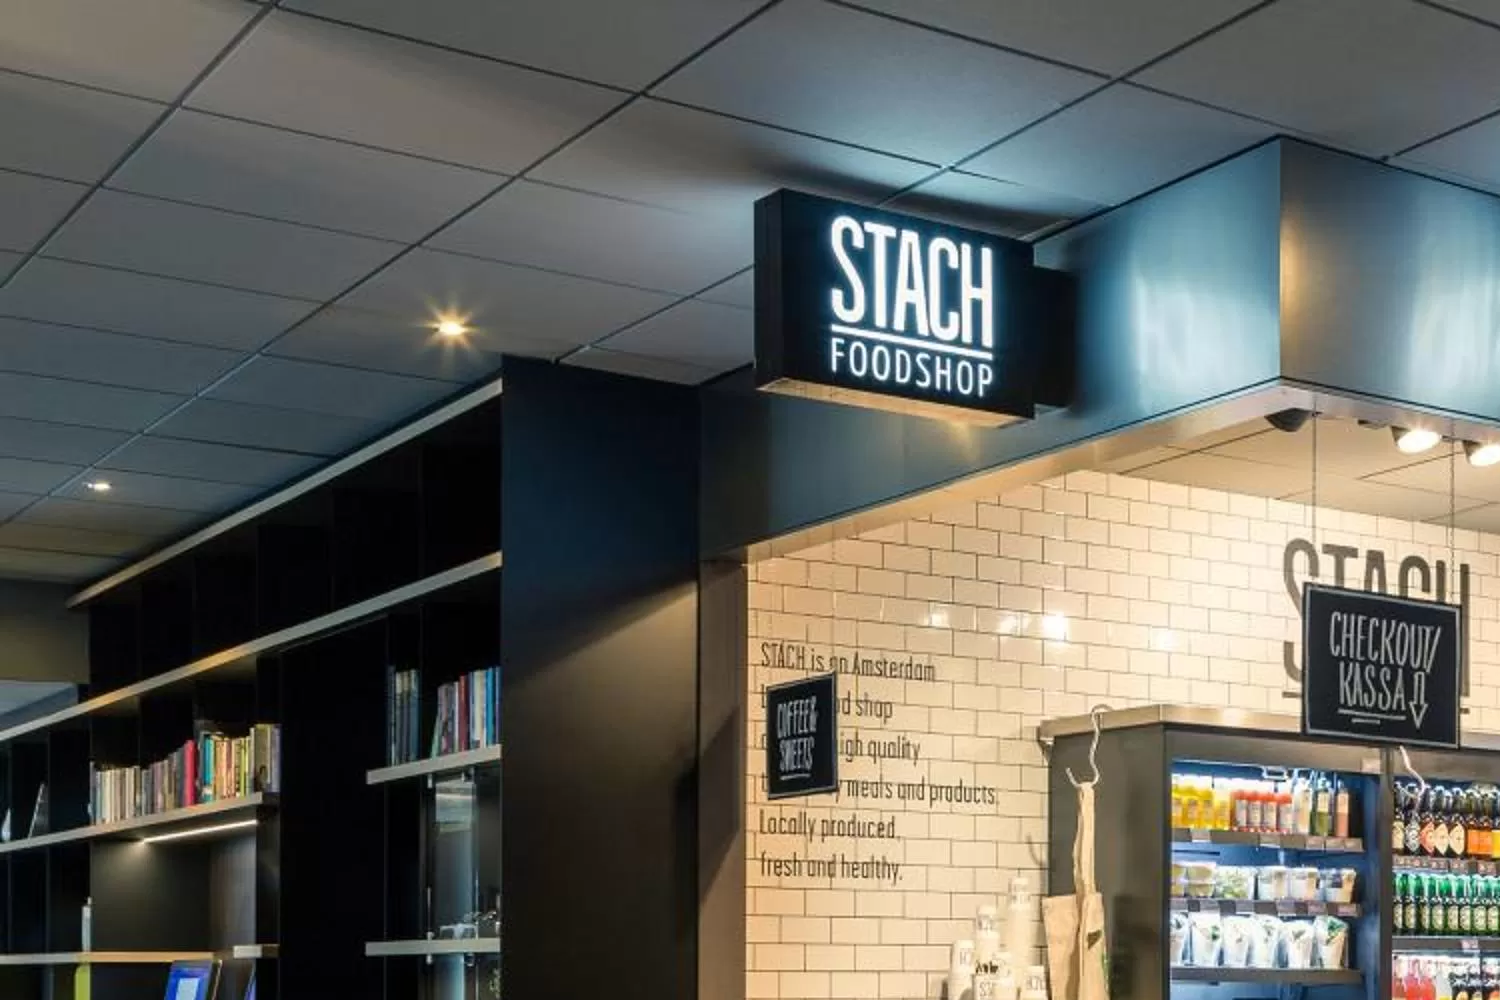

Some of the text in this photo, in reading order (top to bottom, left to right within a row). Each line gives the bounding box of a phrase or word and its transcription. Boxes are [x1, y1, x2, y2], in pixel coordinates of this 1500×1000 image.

[830, 215, 993, 347] STACH
[830, 337, 993, 397] FOODSHOP
[761, 640, 936, 681] STACH is an Amsterdam
[1339, 661, 1406, 711] KASSA
[855, 692, 893, 725] shop
[779, 736, 815, 772] SWEETS
[837, 731, 921, 767] igh quality
[847, 774, 893, 799] meals
[897, 775, 925, 800] and
[759, 808, 817, 843] Locally
[761, 850, 903, 887] fresh and healthy.
